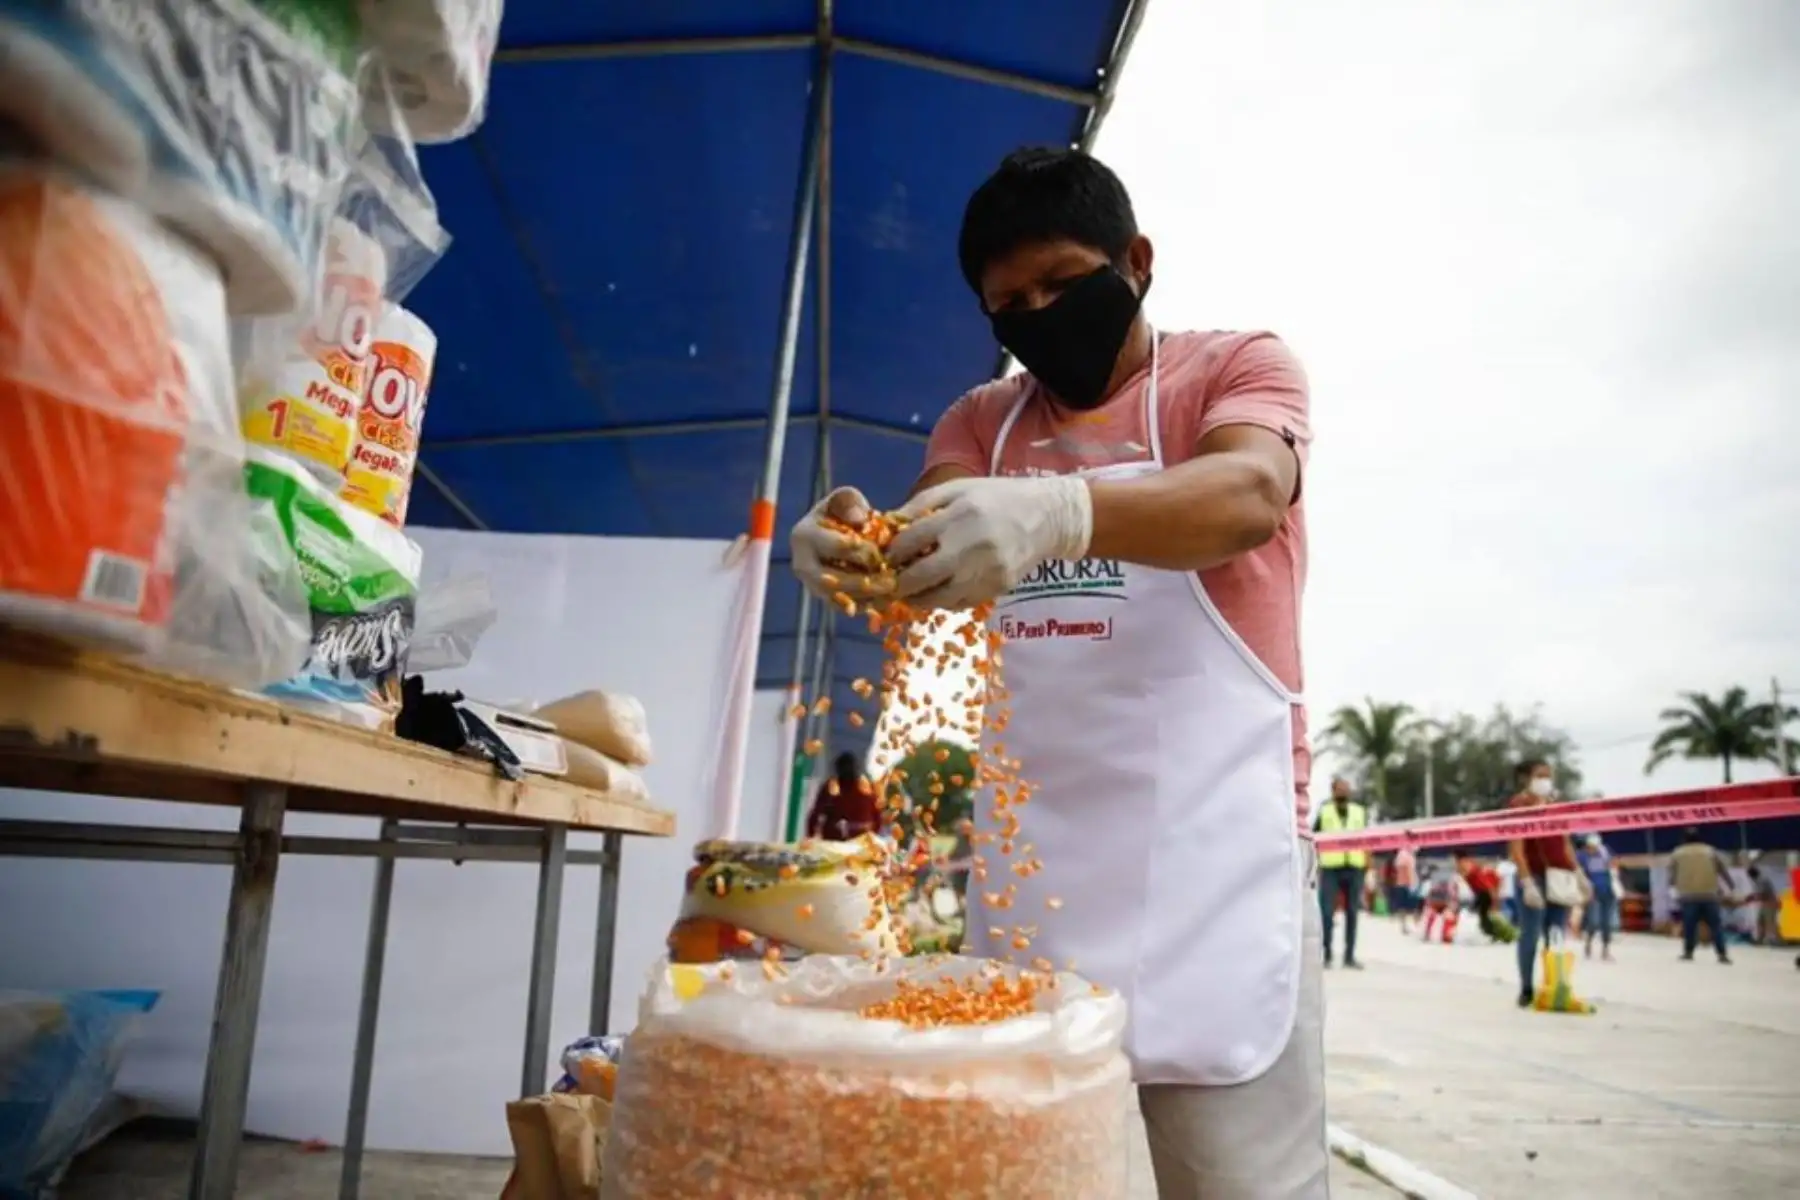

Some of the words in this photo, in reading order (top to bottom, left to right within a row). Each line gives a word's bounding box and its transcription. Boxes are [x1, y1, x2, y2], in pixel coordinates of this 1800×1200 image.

[305, 379, 355, 418] Meg
[266, 399, 288, 438] 1
[1018, 557, 1125, 584] ORURAL
